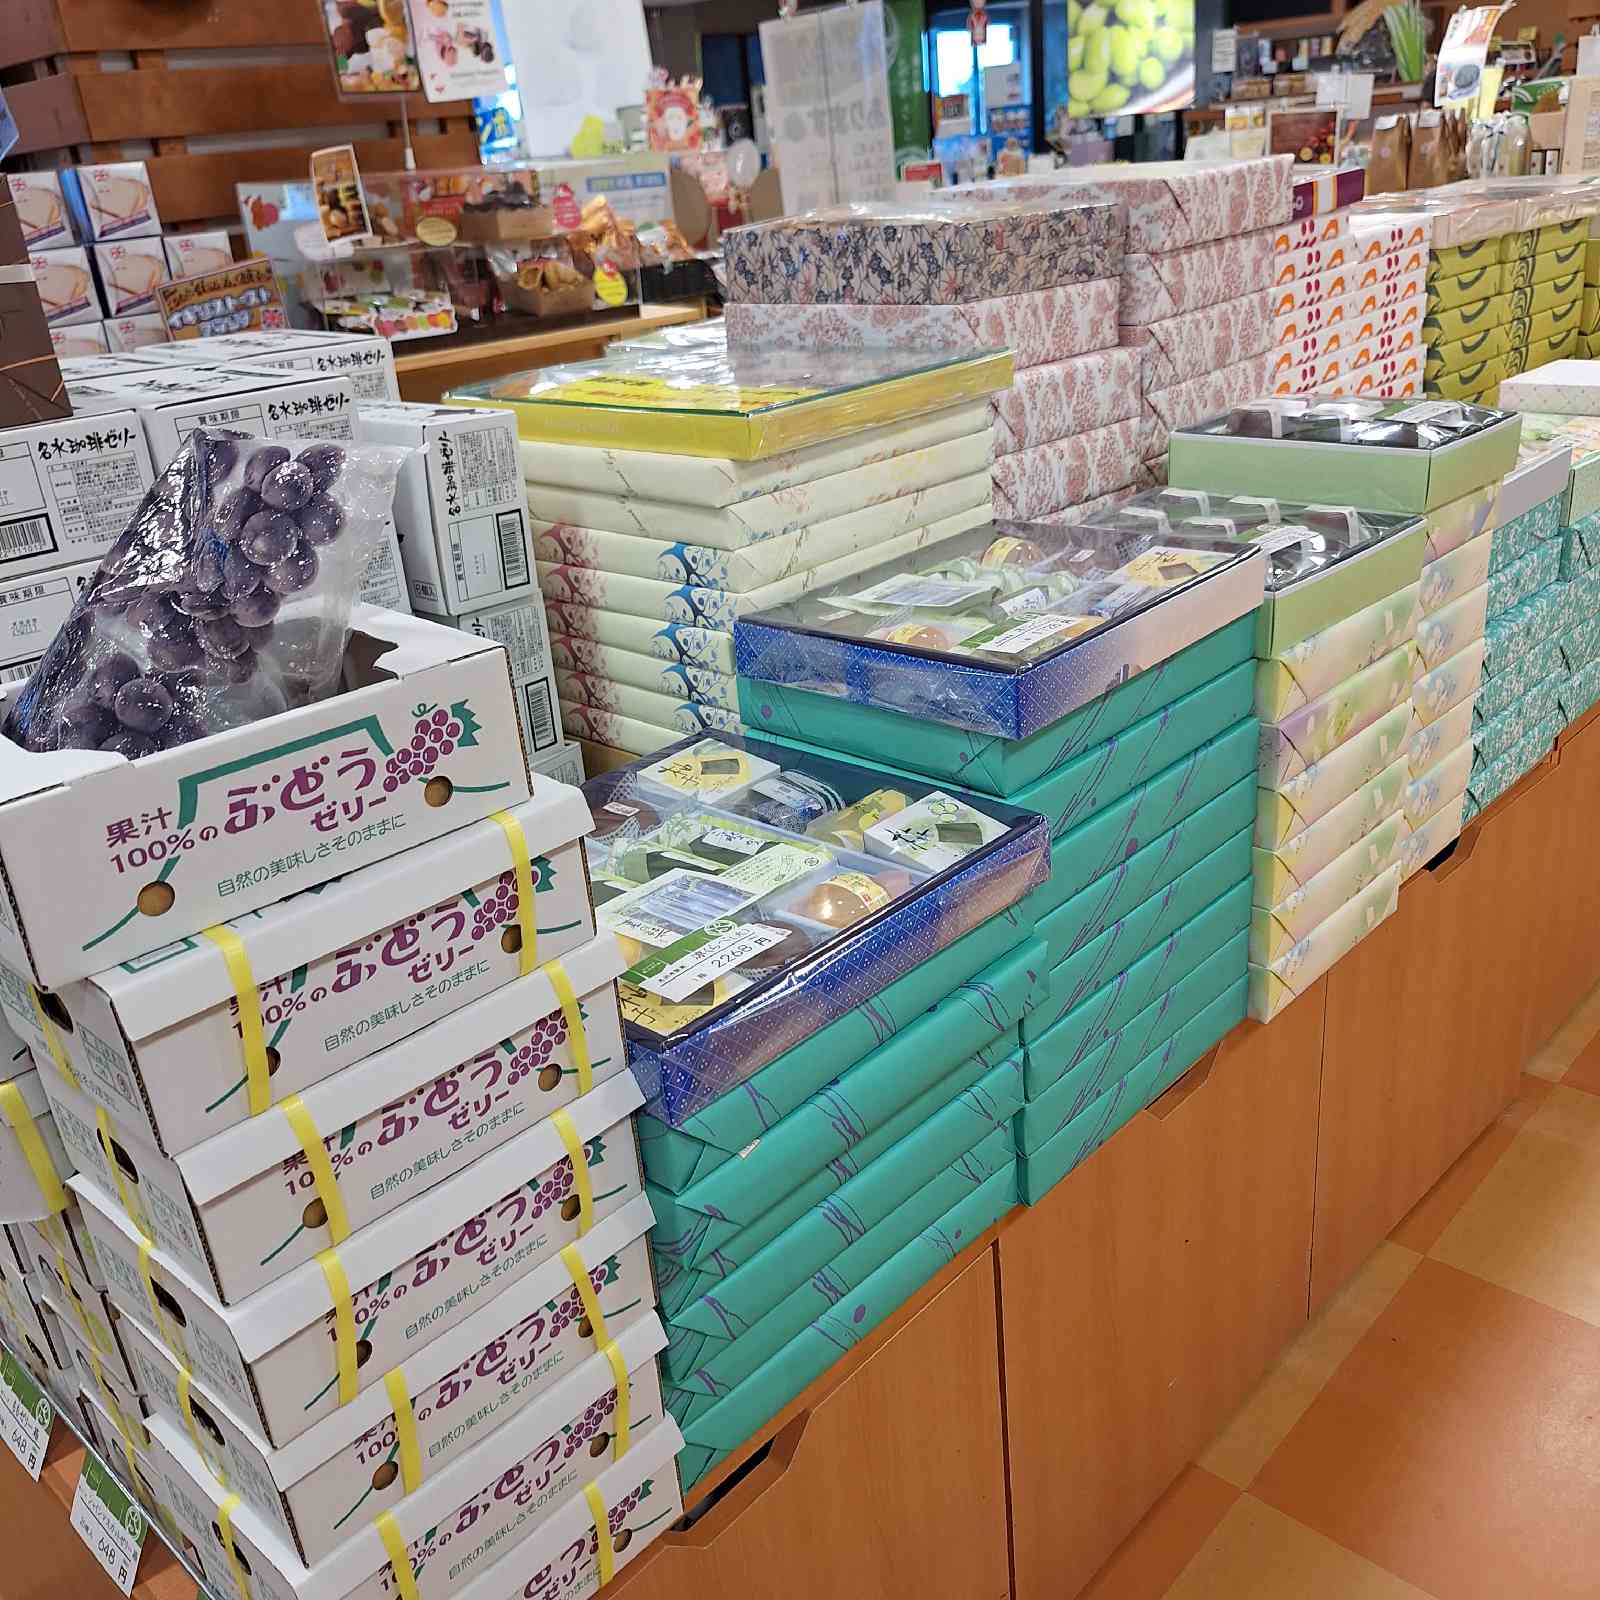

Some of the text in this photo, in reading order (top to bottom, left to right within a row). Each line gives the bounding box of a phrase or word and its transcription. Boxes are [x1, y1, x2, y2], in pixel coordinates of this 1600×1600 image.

[268, 392, 351, 421] 名水珈琲ゼリー
[38, 427, 137, 460] 名水珈琲ゼリー
[106, 807, 173, 848] 果汁
[310, 796, 387, 833] ゼリー
[217, 813, 407, 898] 自然の美味しさそのままに
[408, 944, 475, 985] ゼリー
[711, 936, 772, 969] 2268 円
[324, 959, 491, 1052] 自然の美味しさそのままに
[447, 1089, 511, 1131] ゼリー
[369, 1101, 528, 1201] 自然の美味しさそのままに
[476, 1223, 534, 1265] ゼリー
[498, 1342, 552, 1386] ゼリー
[513, 1461, 567, 1507] ゼリー
[98, 1537, 129, 1586] 648 円
